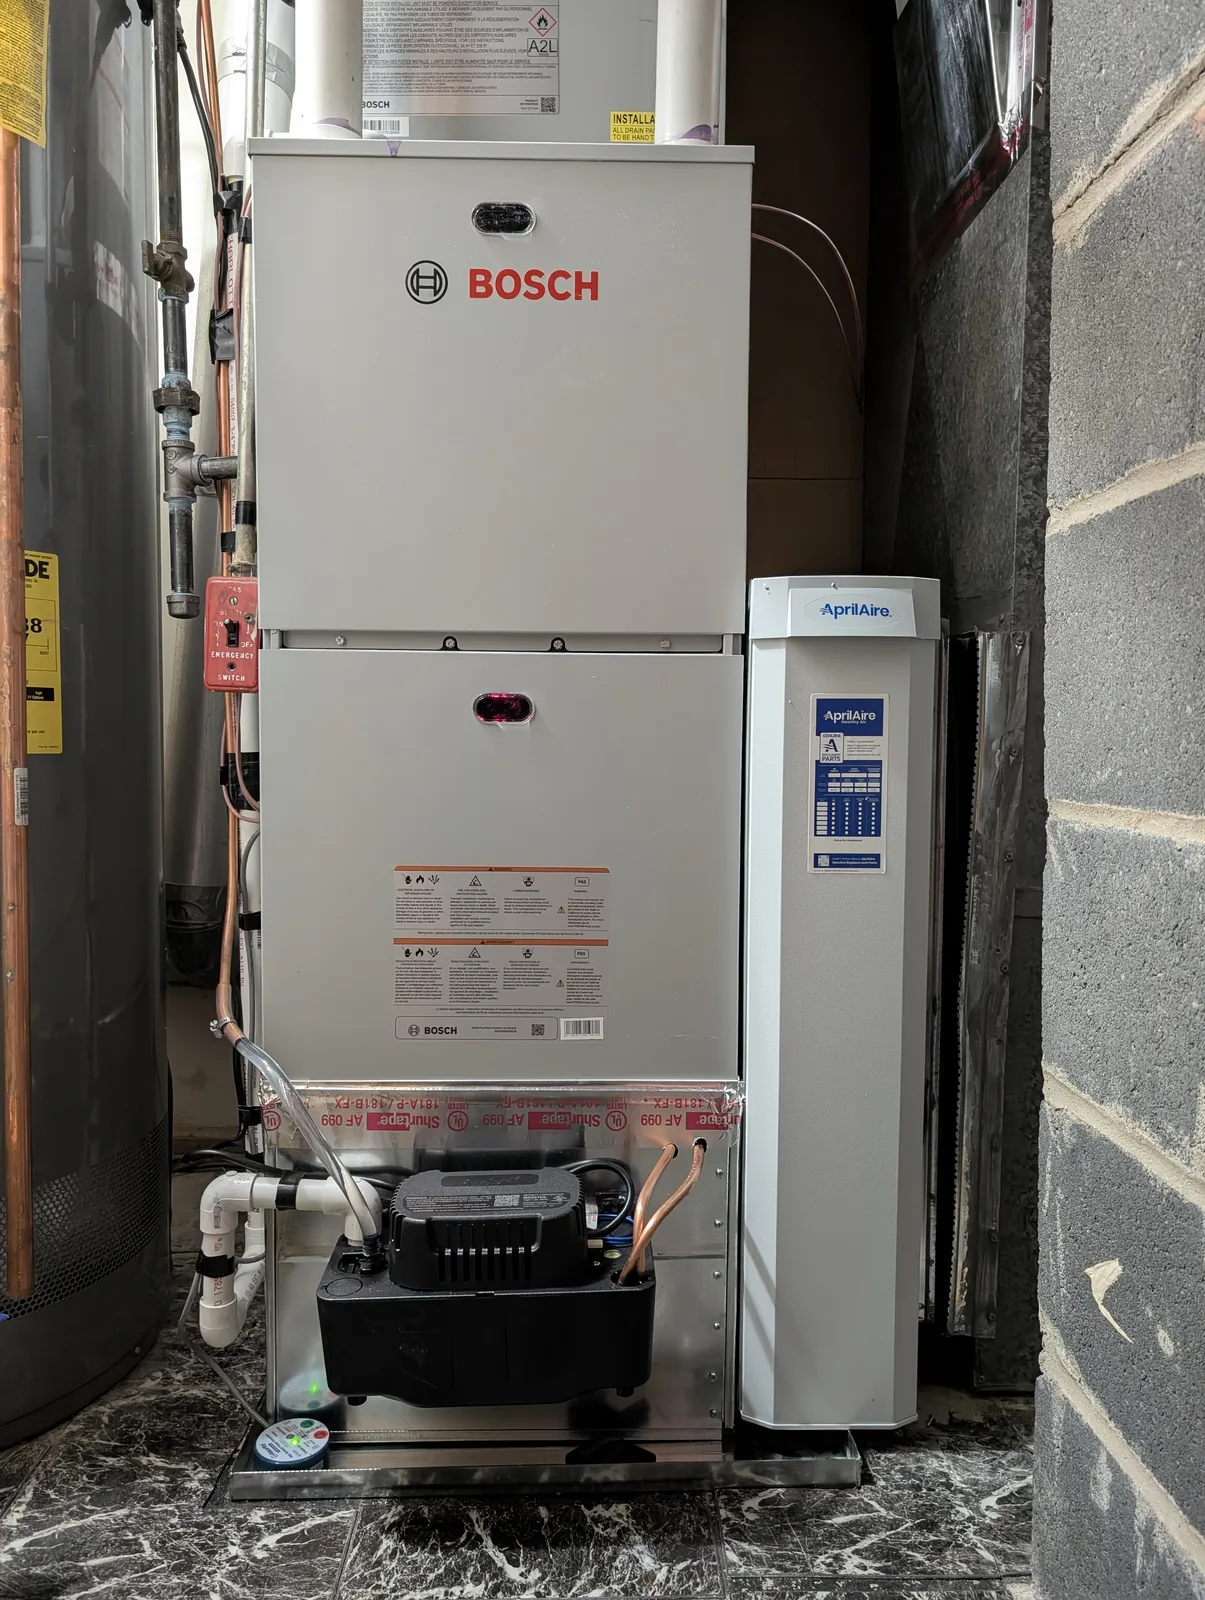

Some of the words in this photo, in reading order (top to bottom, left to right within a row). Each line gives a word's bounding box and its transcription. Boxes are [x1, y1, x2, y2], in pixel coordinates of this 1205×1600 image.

[528, 40, 558, 52] A2L
[469, 268, 599, 301] BOSCH
[25, 559, 50, 579] DE
[820, 602, 889, 619] AprilAire
[211, 651, 254, 659] EMERGENCY
[823, 710, 876, 724] AprilAire
[335, 1098, 386, 1109] 181B-FX
[397, 1099, 439, 1110] 181A-P
[322, 1114, 342, 1126] 099
[346, 1114, 363, 1126] AF
[380, 1113, 440, 1128] Shurtape
[483, 1114, 504, 1126] 099
[508, 1114, 524, 1126] AF
[541, 1114, 600, 1127] Shurtape
[641, 1114, 662, 1126] 099
[666, 1114, 682, 1126] AF
